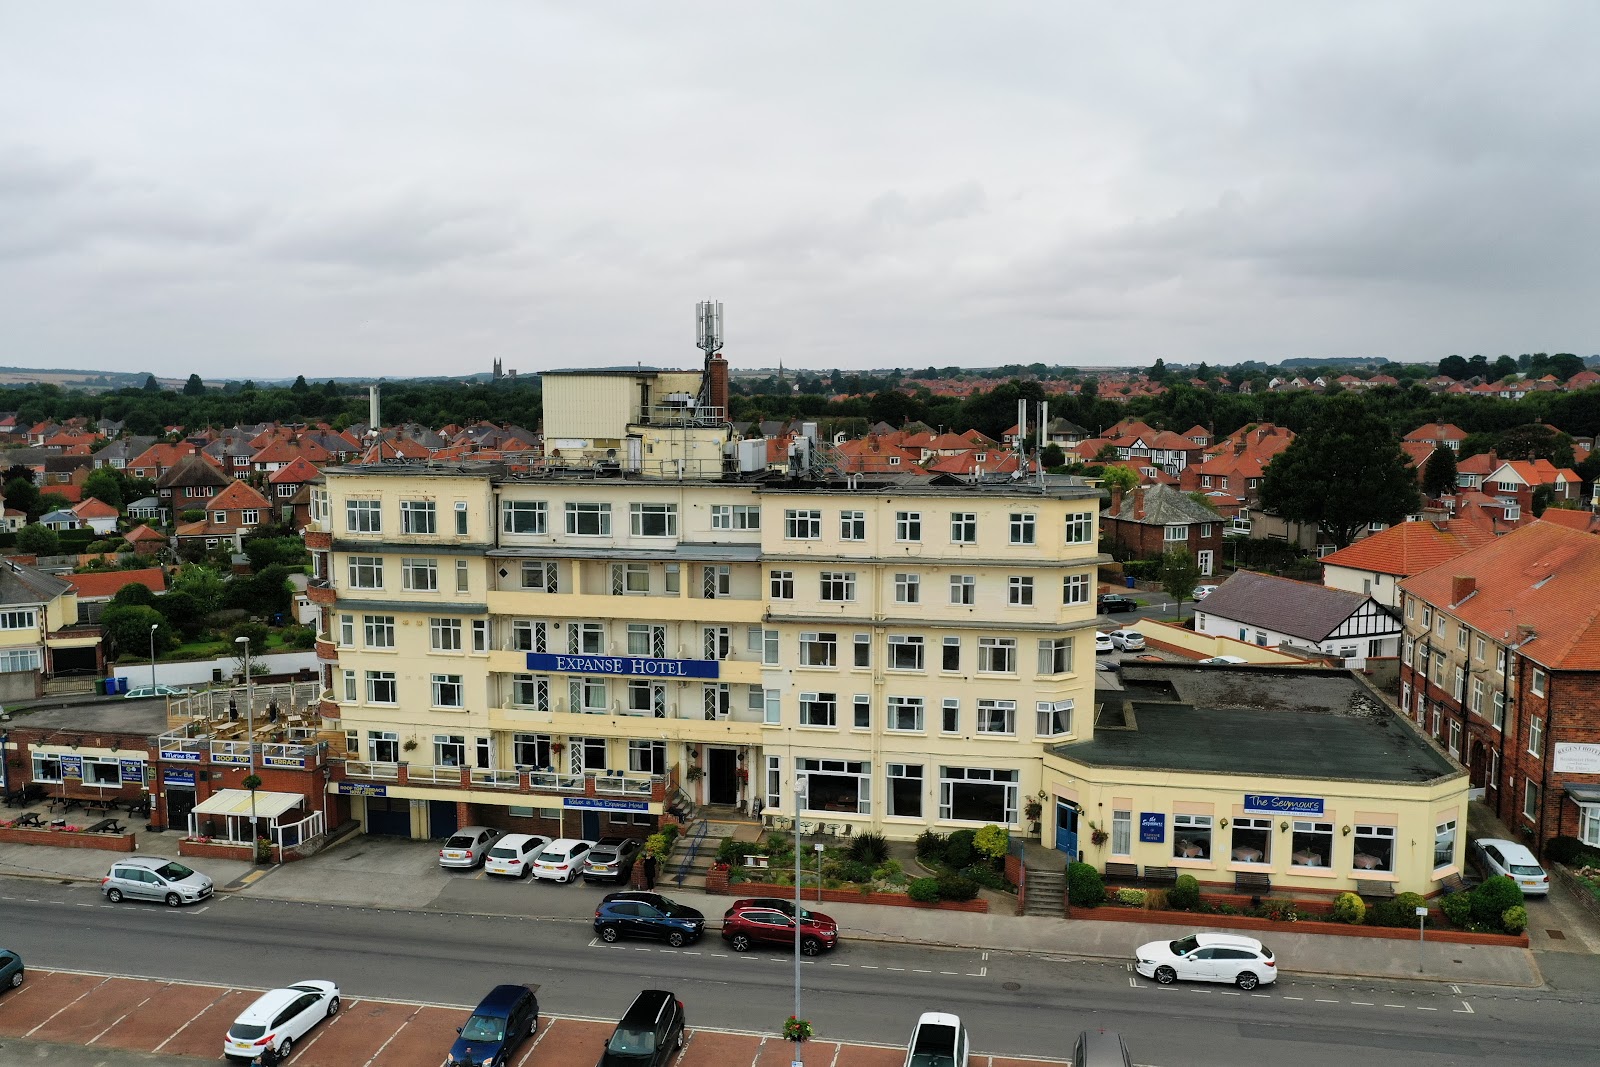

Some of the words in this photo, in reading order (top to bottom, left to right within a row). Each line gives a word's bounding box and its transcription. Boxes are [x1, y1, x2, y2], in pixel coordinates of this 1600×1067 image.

[555, 656, 623, 673] EXPANSE
[631, 659, 687, 676] HOTEL
[269, 758, 301, 766] TERRACE
[604, 801, 627, 809] Expanse
[1249, 795, 1268, 807] The
[1271, 797, 1320, 811] Seymours
